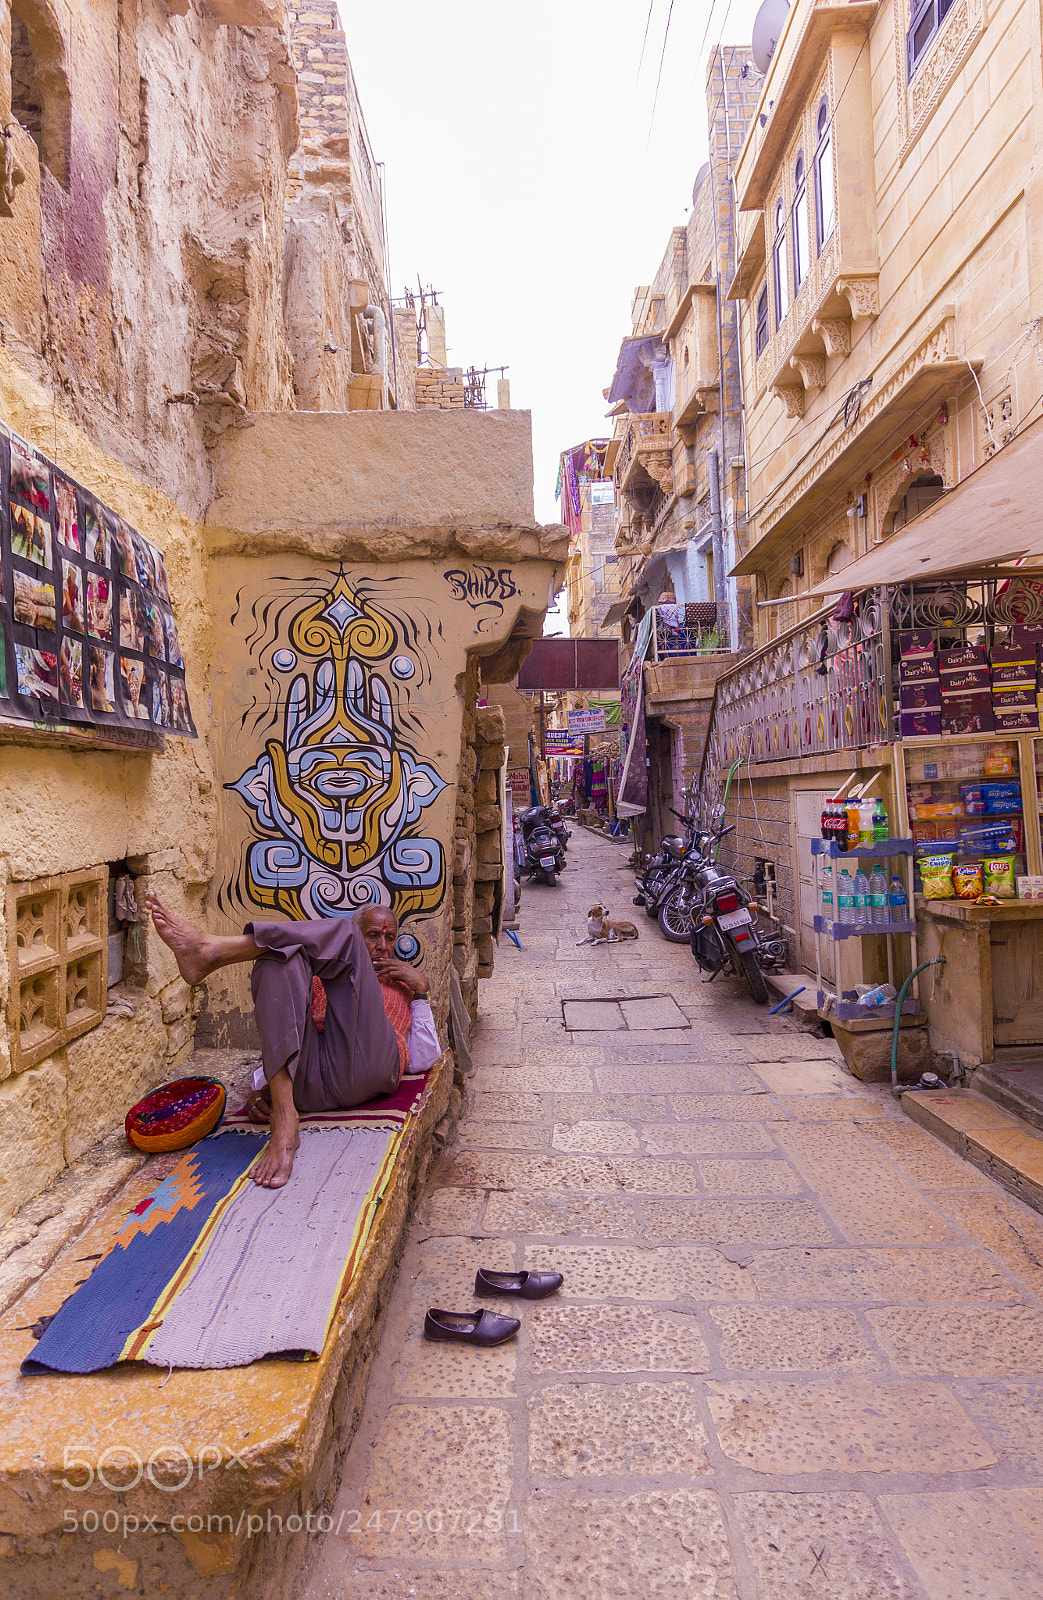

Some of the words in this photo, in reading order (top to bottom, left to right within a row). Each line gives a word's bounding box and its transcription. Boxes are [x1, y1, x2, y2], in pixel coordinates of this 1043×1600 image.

[947, 656, 963, 664] Dairy
[904, 668, 920, 677] Dairy
[949, 678, 966, 687] Dairy
[1002, 719, 1018, 727] Dairy
[508, 772, 529, 780] Mahal
